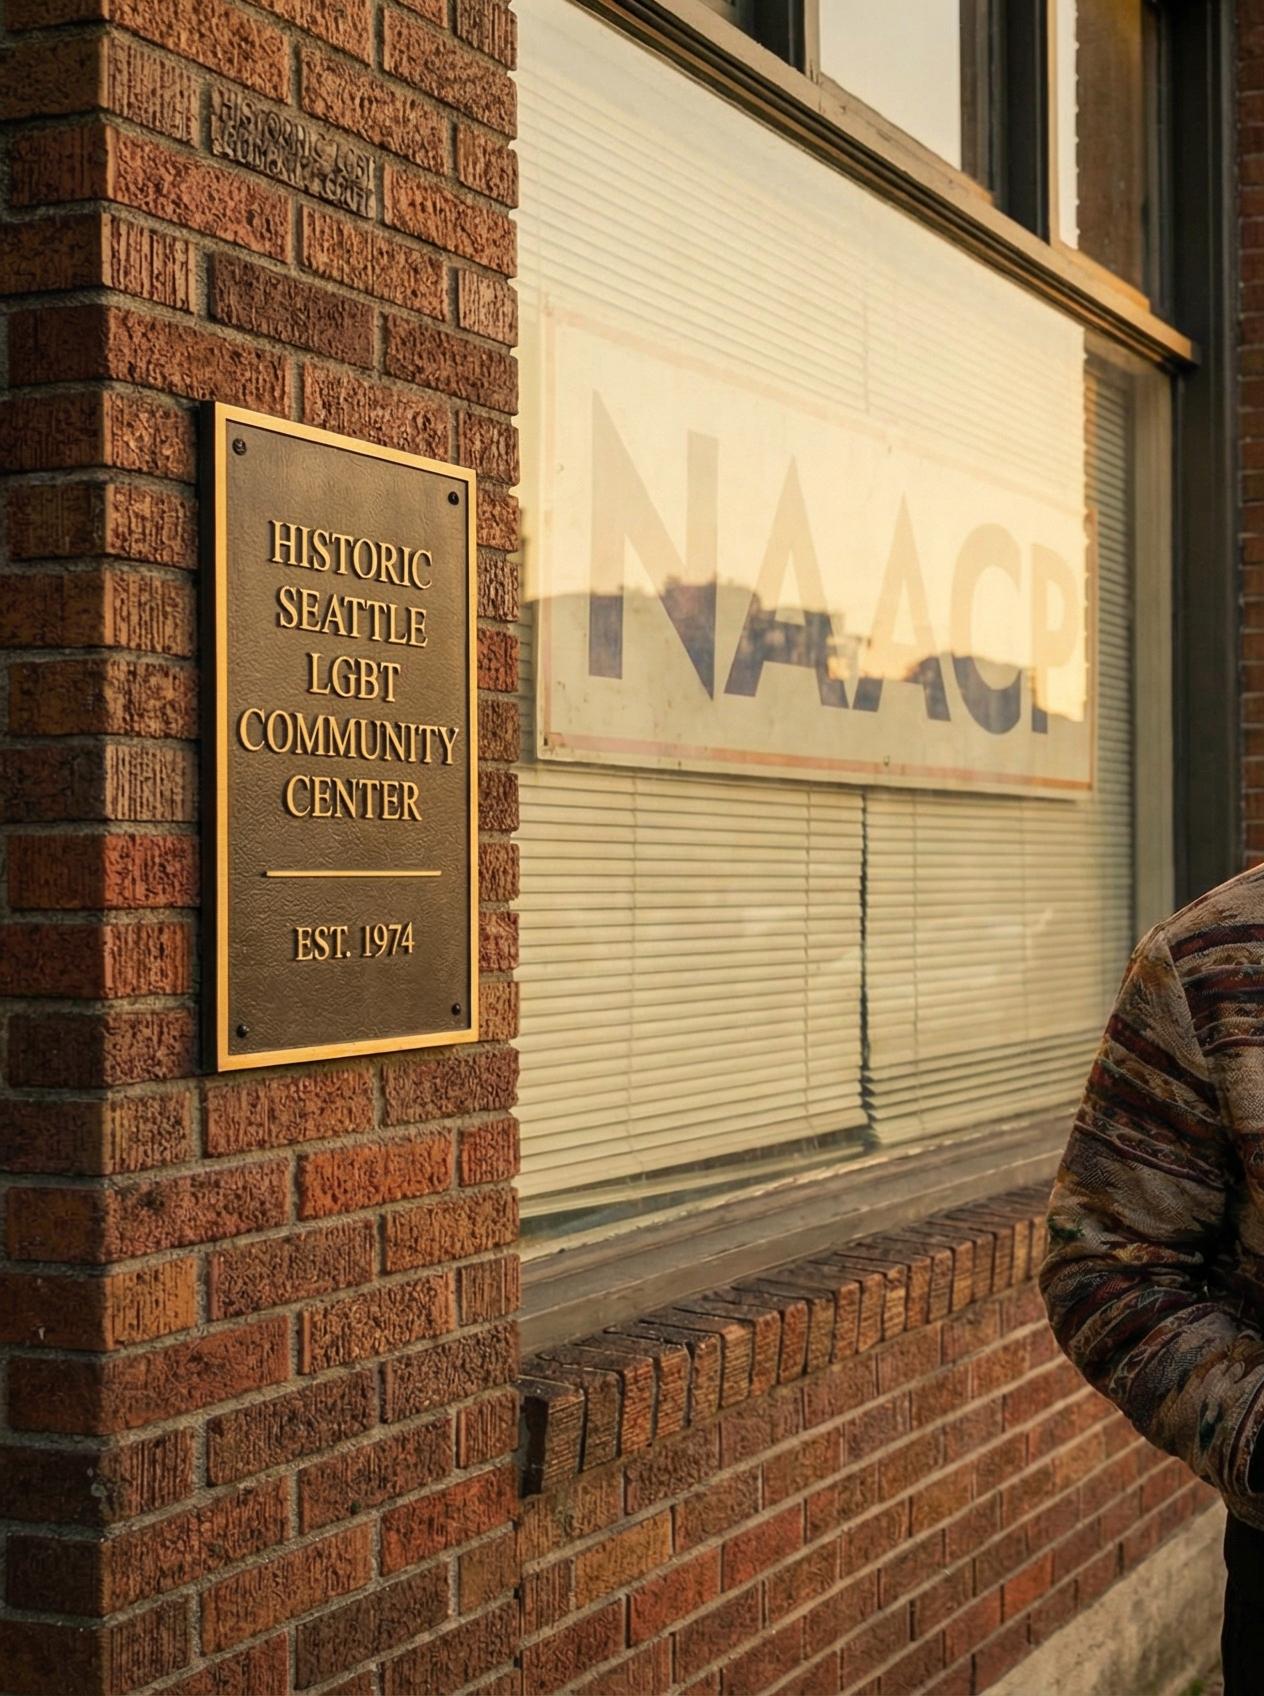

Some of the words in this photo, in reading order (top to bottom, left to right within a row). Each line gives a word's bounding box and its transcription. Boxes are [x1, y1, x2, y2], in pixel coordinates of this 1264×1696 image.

[269, 519, 433, 590] HISTORIC
[588, 387, 1079, 735] NAACP
[278, 585, 428, 647] SEATTLE
[308, 652, 401, 702] LGBT
[239, 708, 459, 765] COMMUNITY
[285, 775, 422, 821] CENTER
[295, 926, 351, 961] EST.
[362, 922, 415, 958] 1974
